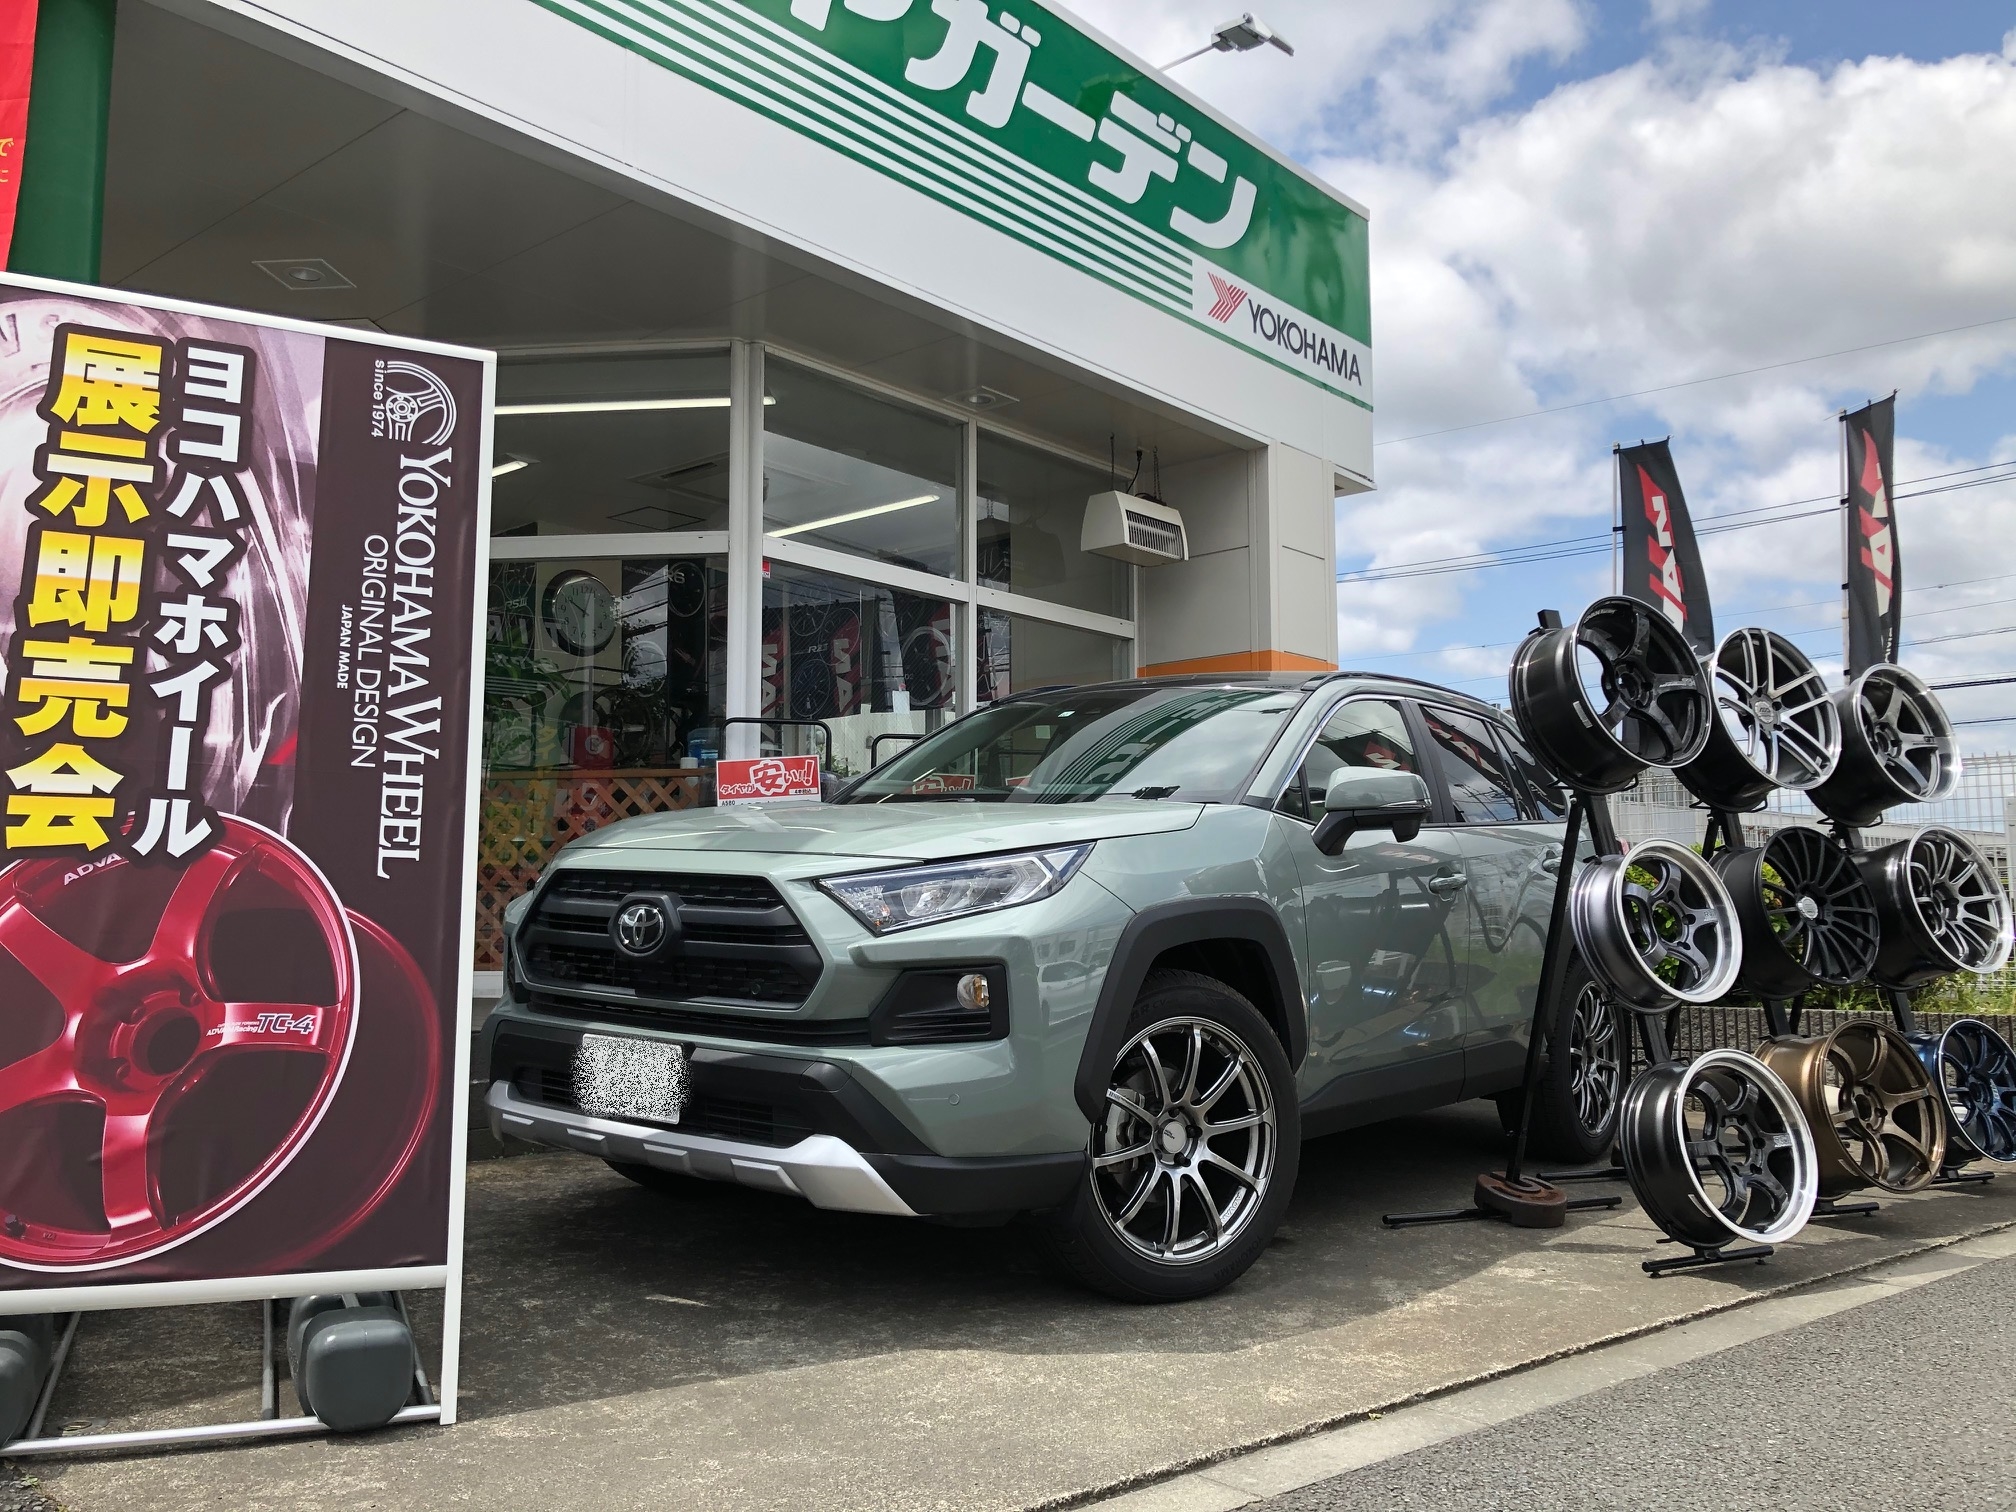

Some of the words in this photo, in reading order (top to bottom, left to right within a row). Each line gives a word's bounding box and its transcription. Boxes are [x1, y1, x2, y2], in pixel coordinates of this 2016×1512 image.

[373, 359, 387, 400] since
[1248, 298, 1362, 387] YOKOHAMA
[371, 402, 385, 438] 1974
[5, 333, 164, 852] 展示即売会
[132, 345, 245, 859] ヨコハマホイール
[357, 534, 389, 661] ORIGINAL
[387, 447, 453, 697] YOKOHAMA
[336, 650, 350, 690] MADE
[338, 604, 353, 647] JAPAN
[351, 668, 382, 768] DESIGN
[376, 696, 442, 880] WHEEL
[64, 852, 123, 886] ADVA
[257, 1013, 317, 1034] TC-4
